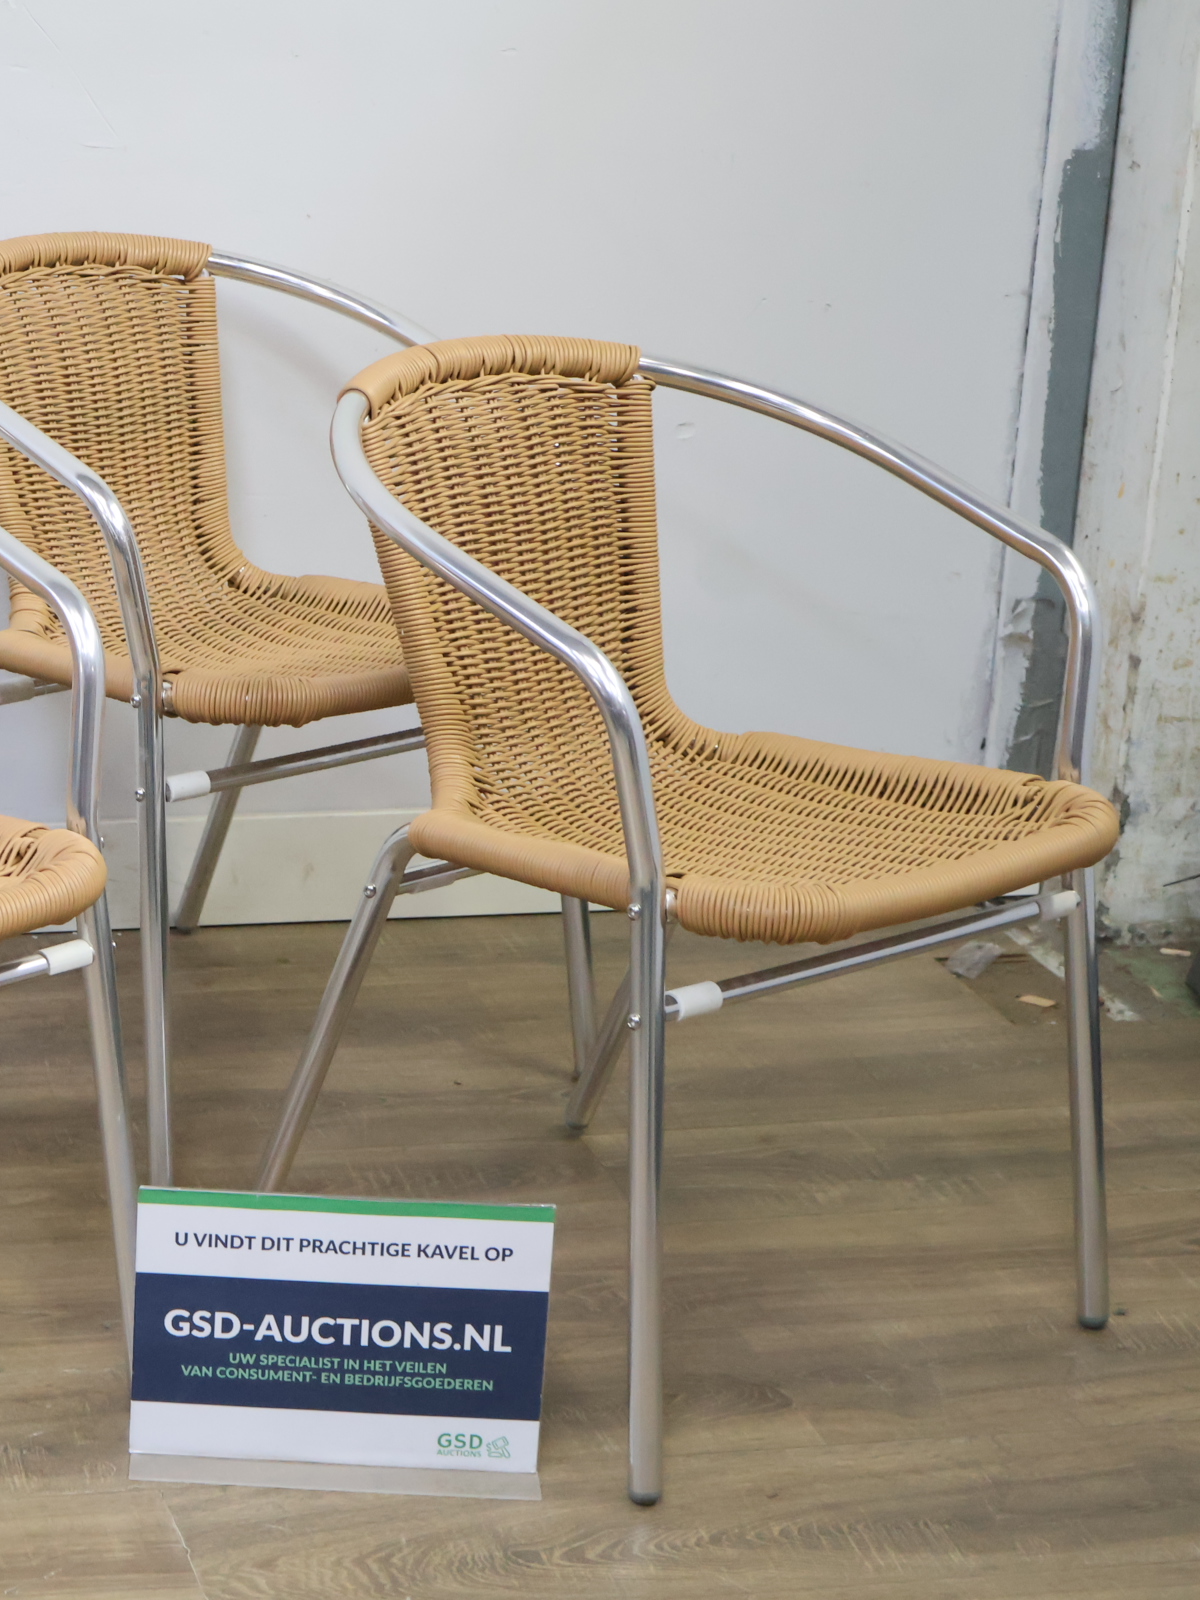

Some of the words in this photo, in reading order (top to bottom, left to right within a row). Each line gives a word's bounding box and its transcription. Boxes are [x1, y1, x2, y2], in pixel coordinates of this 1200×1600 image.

[174, 1232, 188, 1247] U
[193, 1233, 256, 1250] VINDT
[261, 1236, 294, 1252] DIT
[299, 1238, 411, 1257] PRACHTIGE
[417, 1243, 480, 1261] KAVEL
[485, 1247, 514, 1262] OP
[164, 1308, 512, 1353] GSD-AUCTIONS.NL
[229, 1352, 257, 1366] UW
[259, 1354, 341, 1370] SPECIALIST
[344, 1358, 359, 1371] IN
[363, 1358, 394, 1373] HET
[395, 1360, 447, 1374] VEILEN
[181, 1364, 213, 1378] VAN
[216, 1366, 317, 1384] CONSUMENT-
[321, 1371, 341, 1385] EN
[344, 1372, 493, 1391] BEDRIJFSGOEDEREN
[437, 1433, 483, 1449] GSD
[437, 1449, 482, 1458] AUCTIONS
